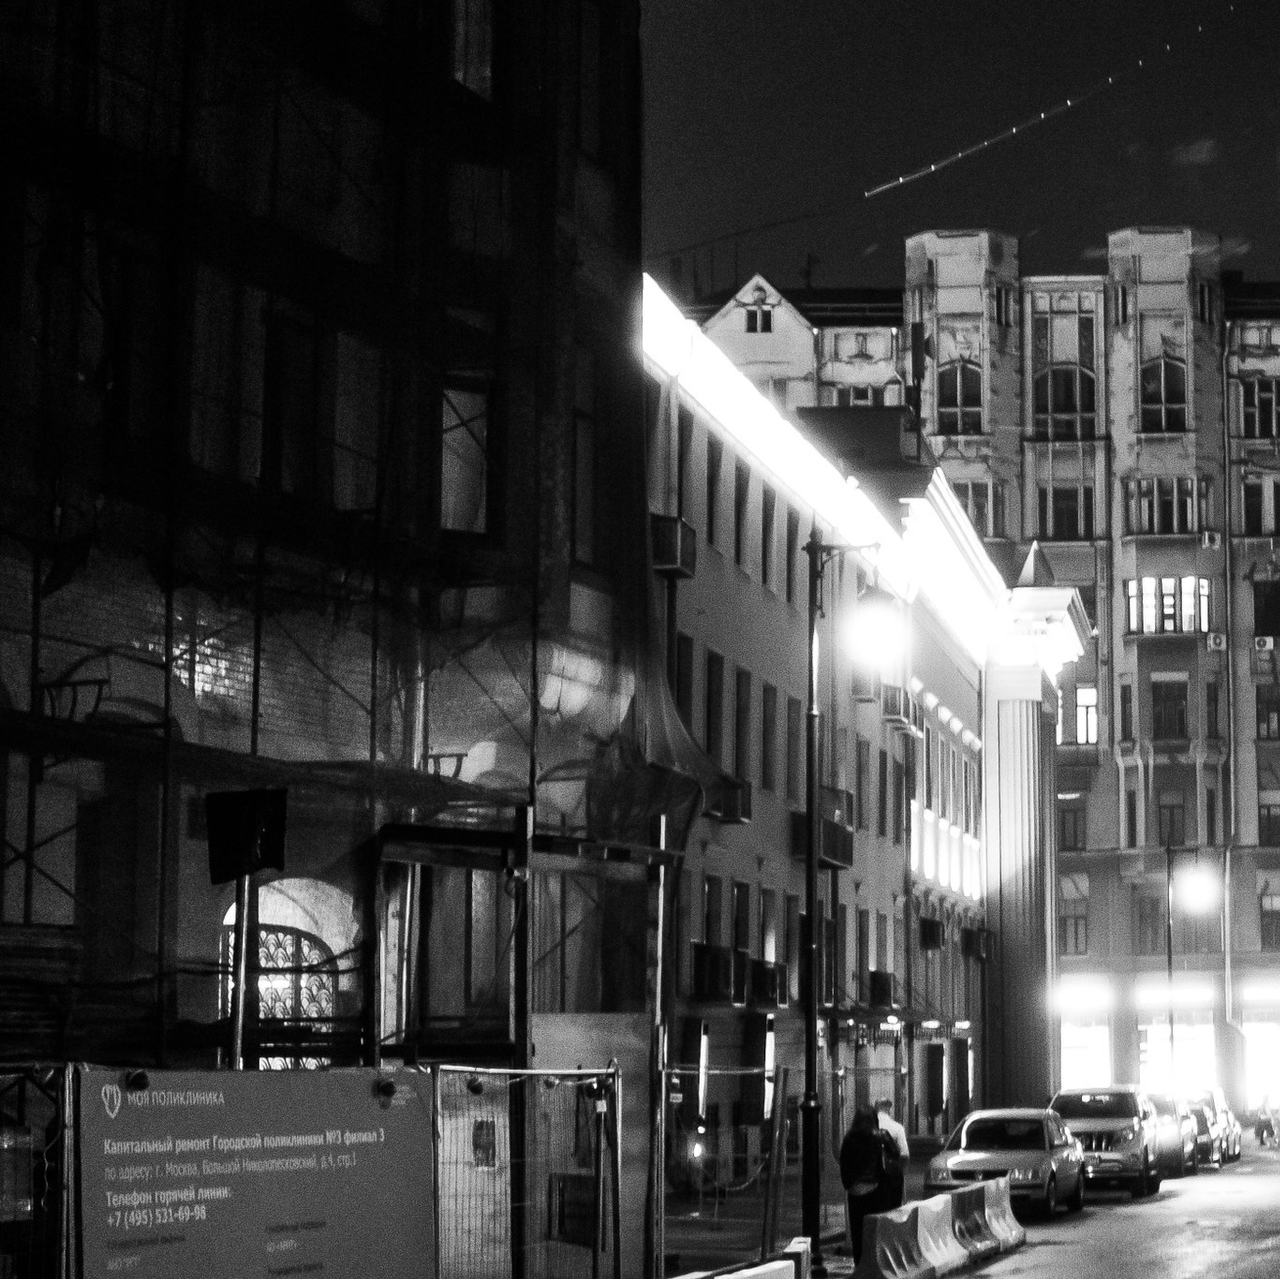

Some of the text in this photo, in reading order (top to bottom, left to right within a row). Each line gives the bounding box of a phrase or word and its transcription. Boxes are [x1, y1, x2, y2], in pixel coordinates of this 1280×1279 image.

[128, 1091, 226, 1106] МОЯ ПОЛИКЛИНИКА
[104, 1136, 173, 1155] Капитальный
[175, 1138, 210, 1155] ремонт
[212, 1133, 262, 1153] Городской
[106, 1189, 152, 1209] Телефон
[154, 1183, 196, 1206] горячей
[107, 1210, 121, 1228] +7
[124, 1208, 153, 1230] (495)
